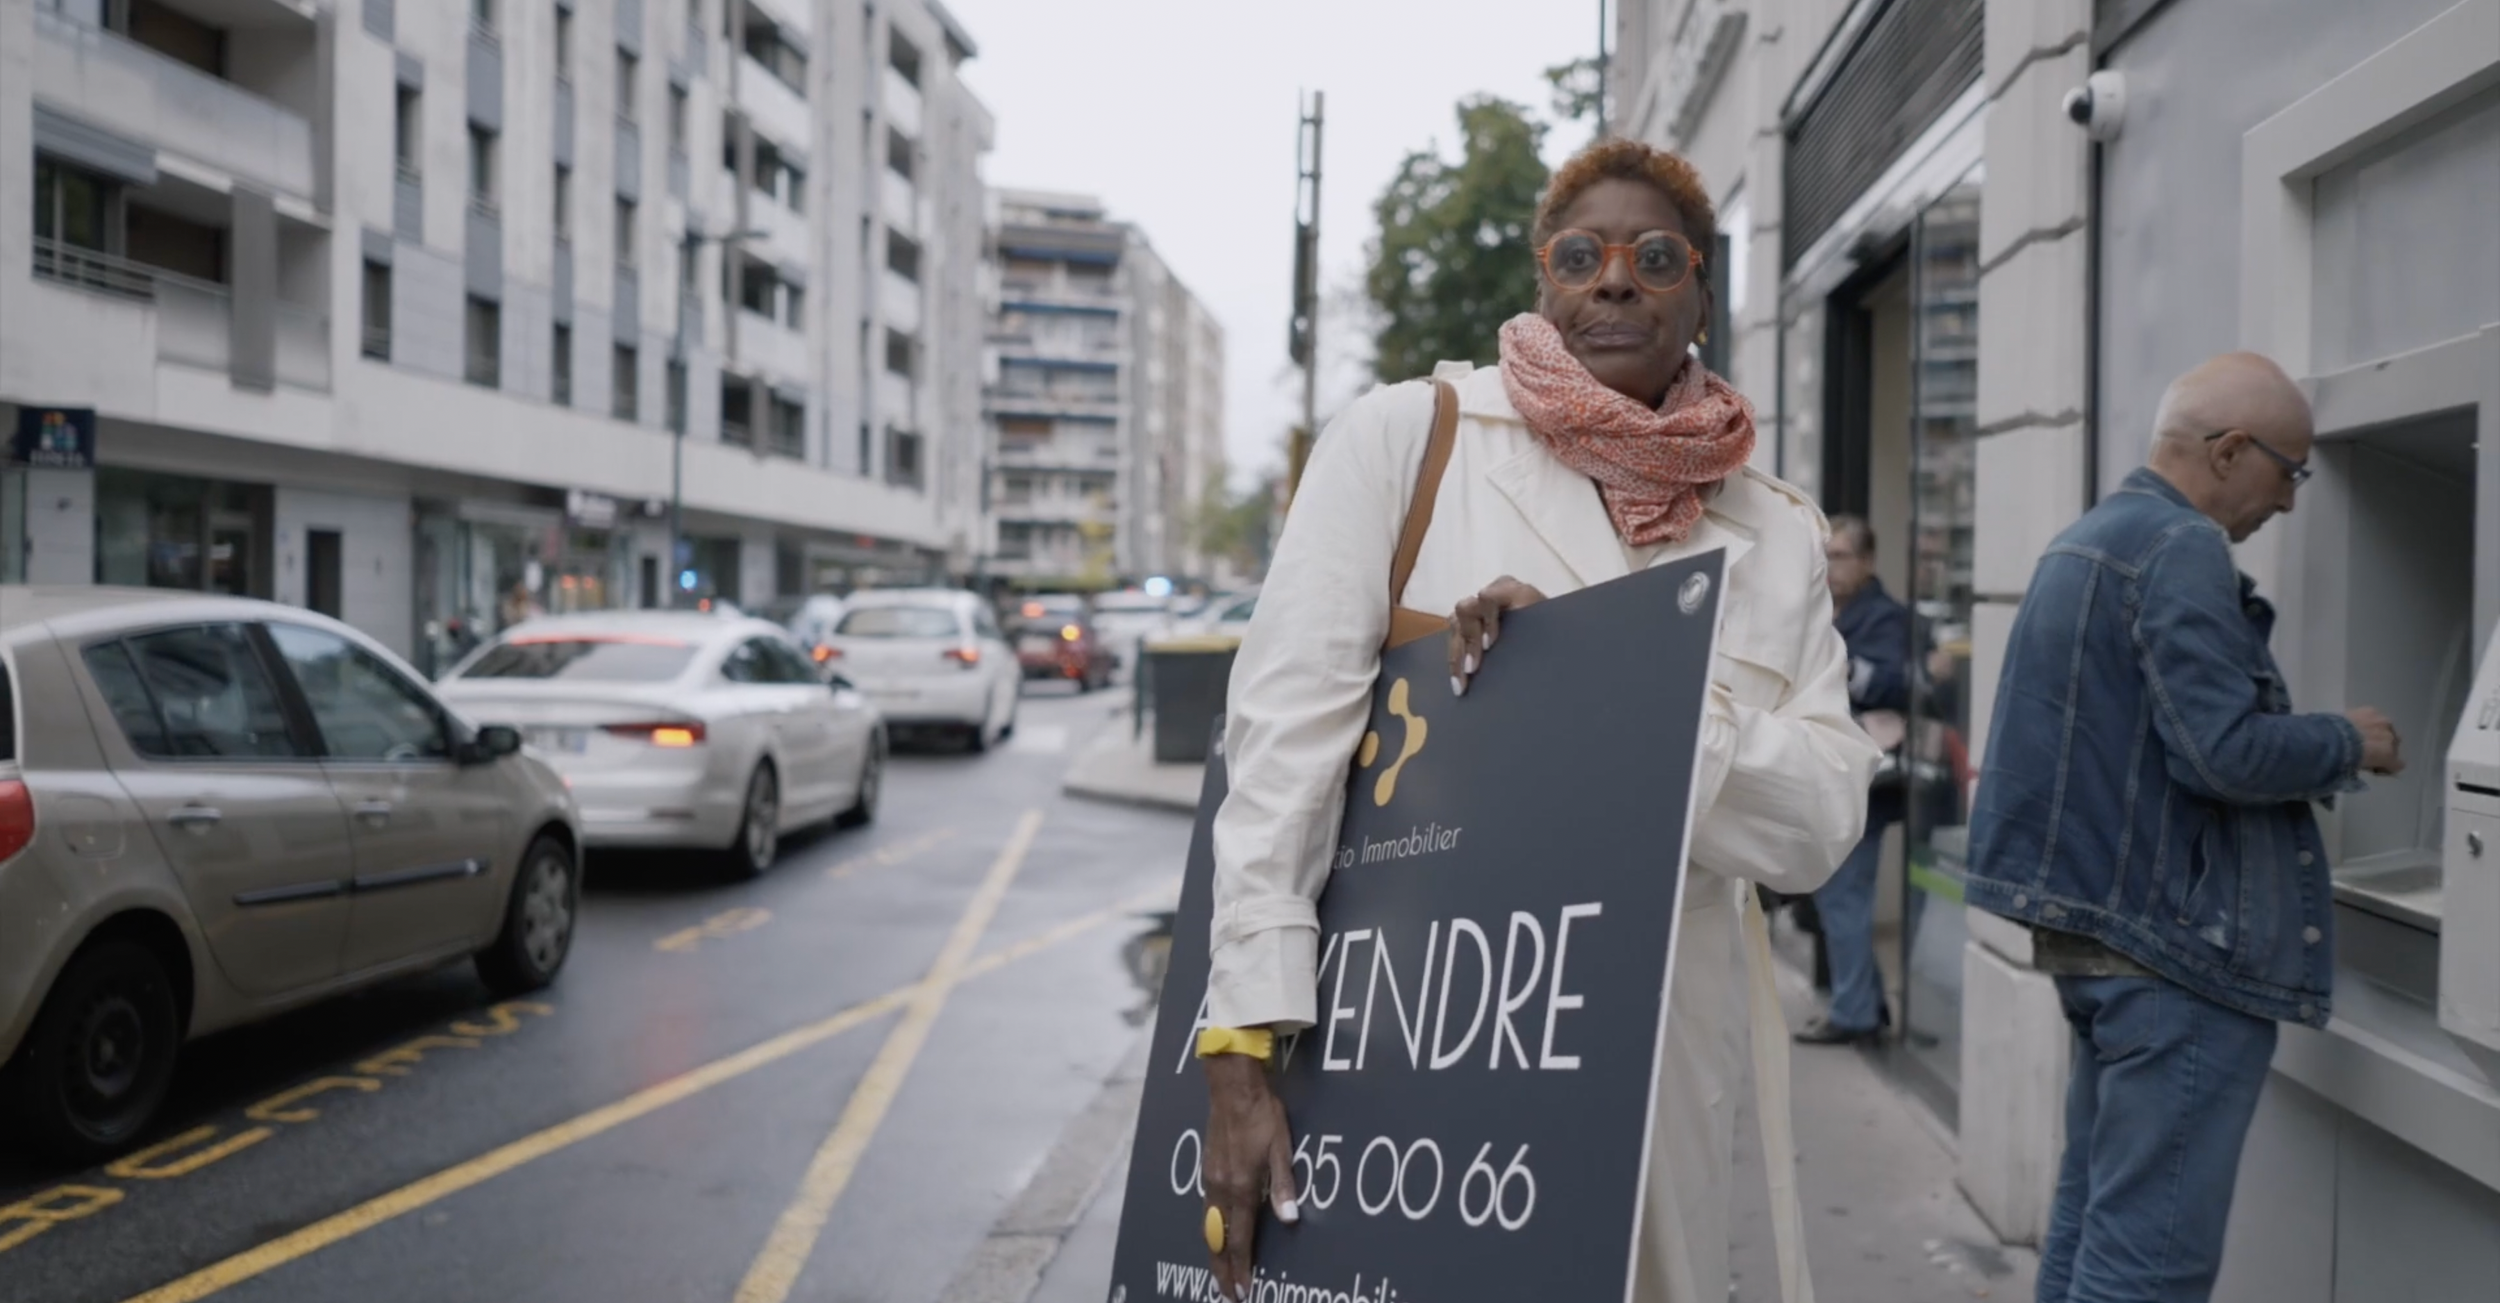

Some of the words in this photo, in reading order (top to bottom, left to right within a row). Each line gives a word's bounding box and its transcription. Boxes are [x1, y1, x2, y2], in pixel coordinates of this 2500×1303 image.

[1361, 822, 1462, 865] Immobilier
[1171, 1128, 1206, 1197] 0
[1291, 1134, 1343, 1209] 65
[1356, 1136, 1443, 1220] 00
[1459, 1141, 1536, 1231] 66
